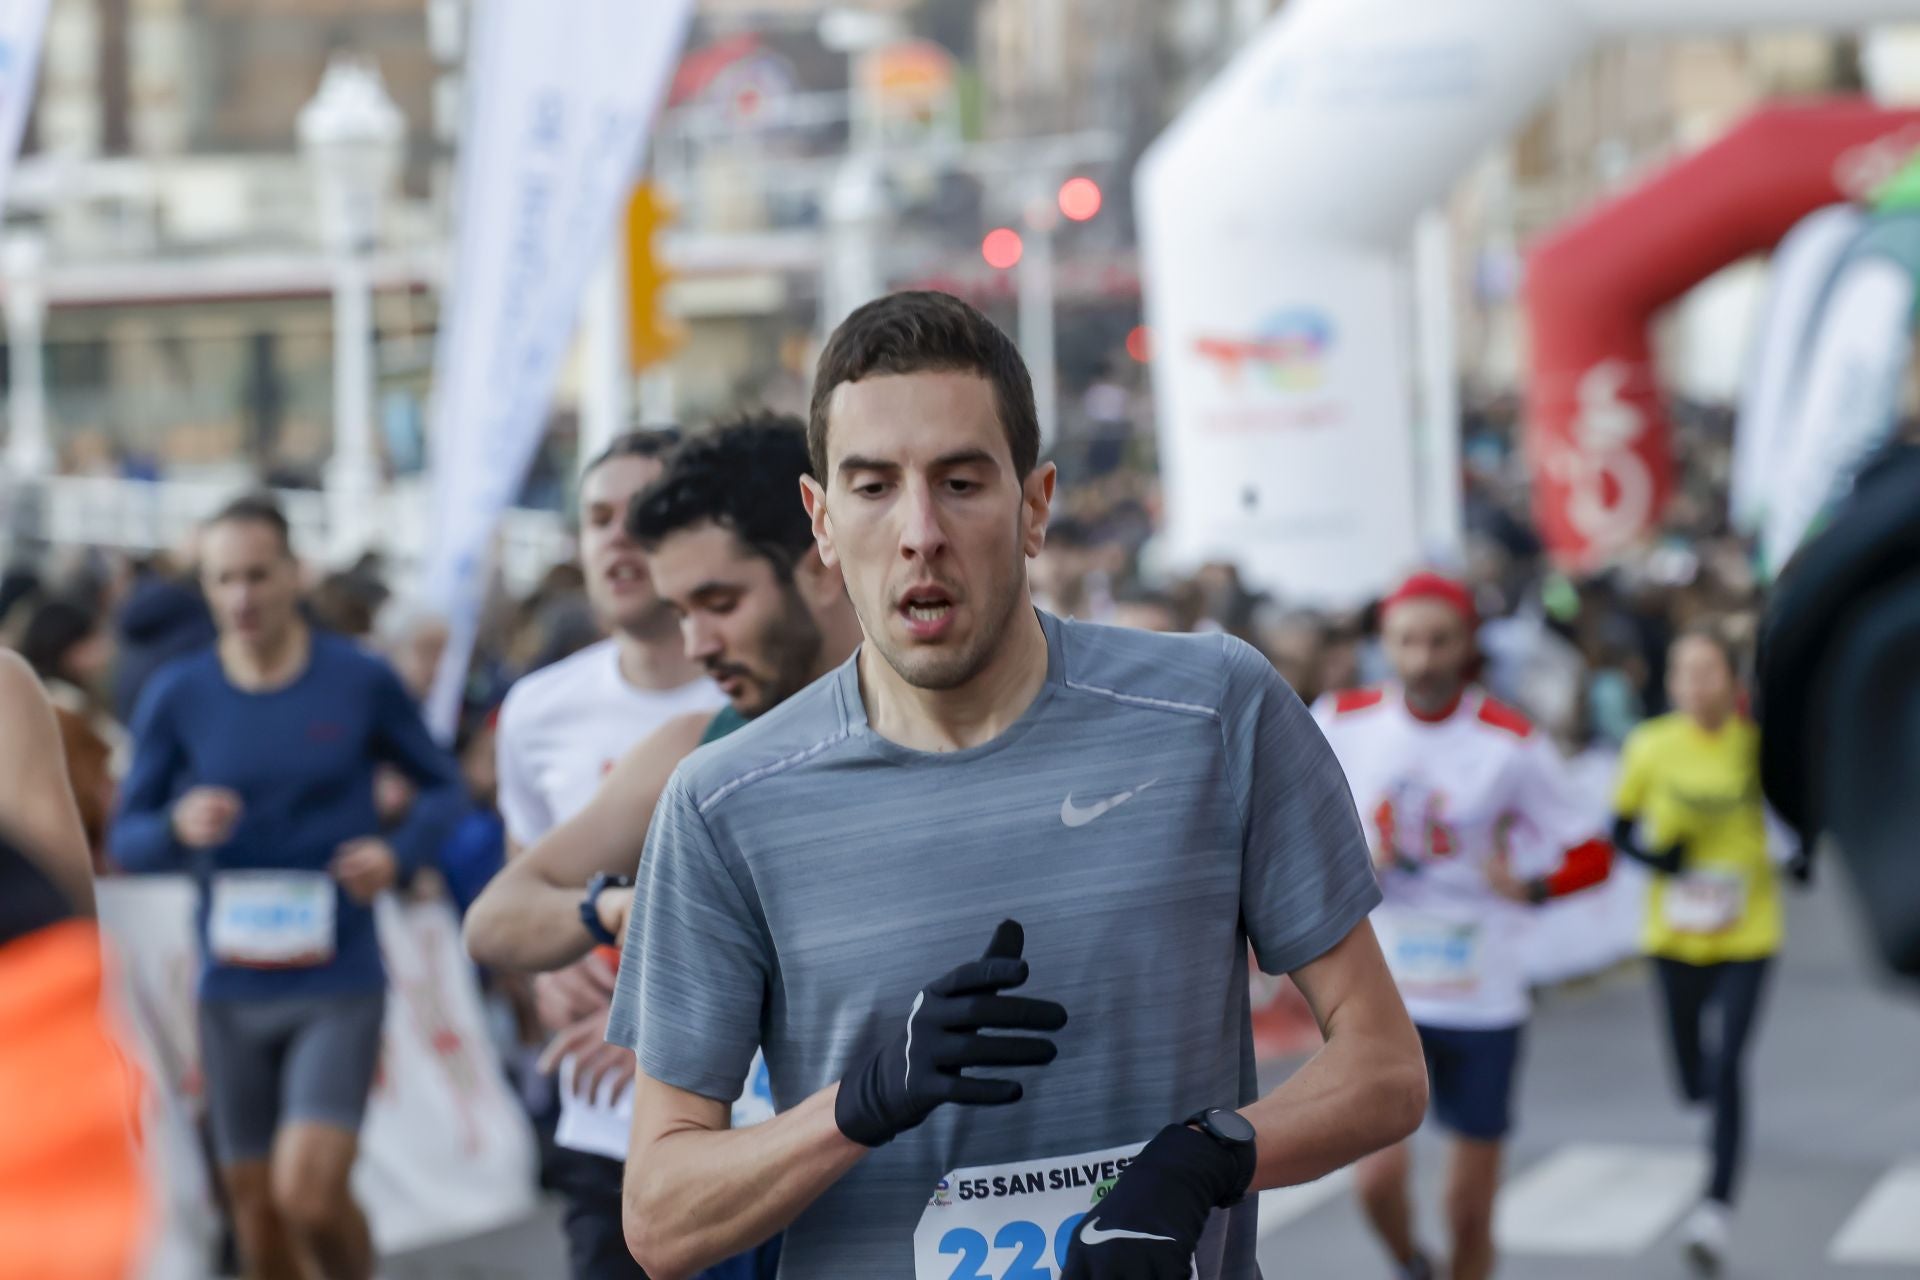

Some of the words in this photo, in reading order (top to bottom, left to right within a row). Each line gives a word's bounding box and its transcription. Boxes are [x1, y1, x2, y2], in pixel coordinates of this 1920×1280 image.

[959, 1178, 990, 1200] 55
[992, 1171, 1046, 1197] SAN
[1048, 1156, 1134, 1190] SILVES
